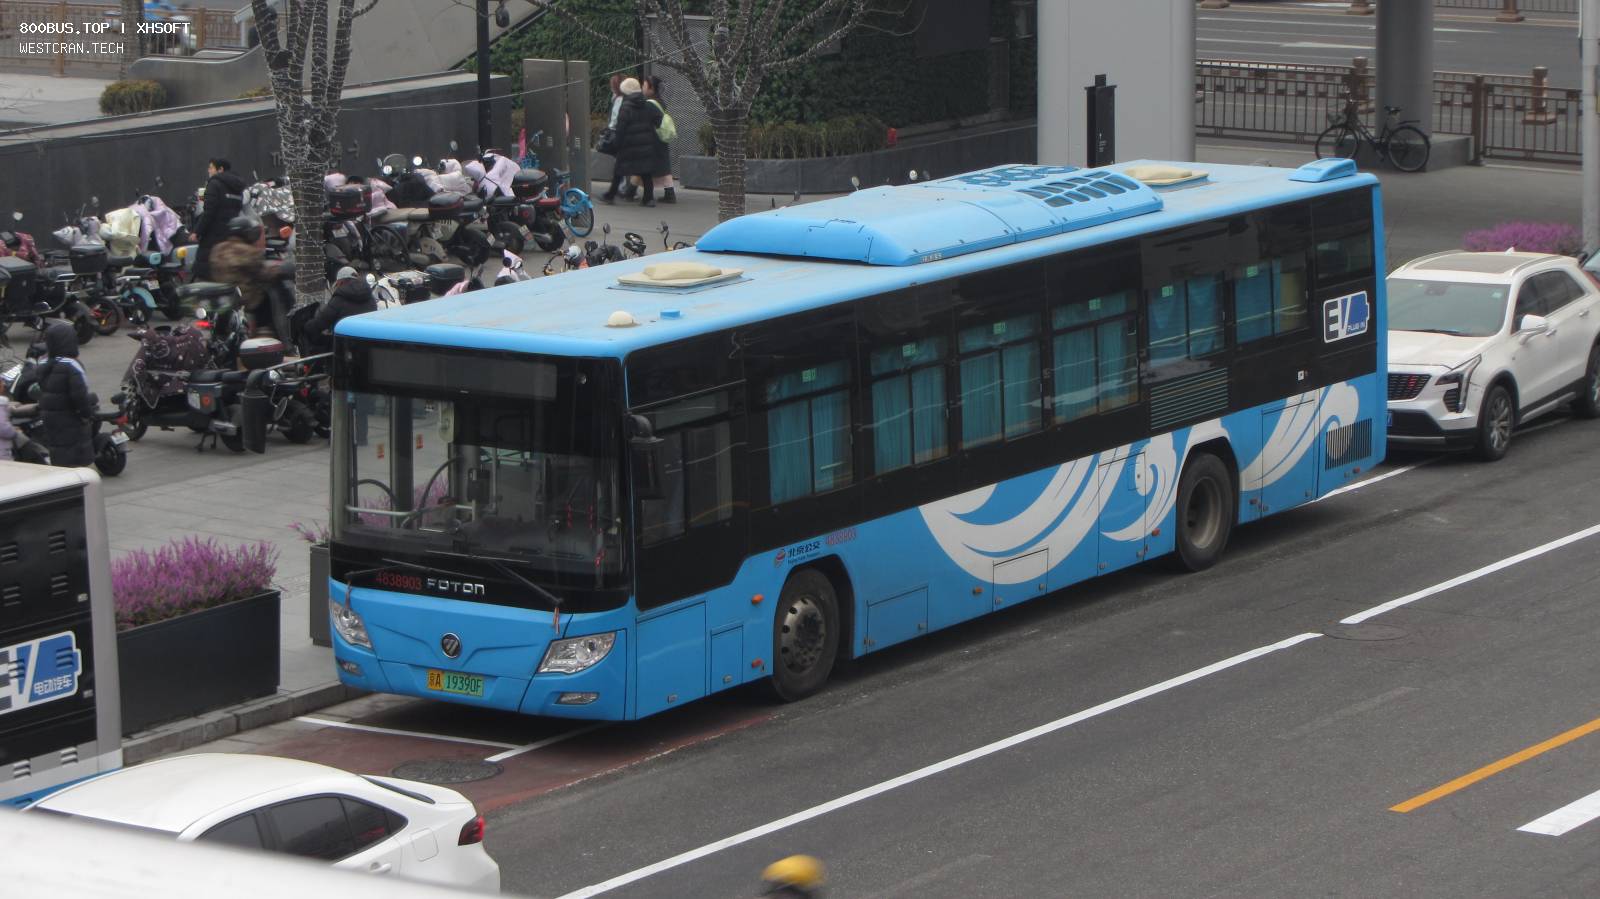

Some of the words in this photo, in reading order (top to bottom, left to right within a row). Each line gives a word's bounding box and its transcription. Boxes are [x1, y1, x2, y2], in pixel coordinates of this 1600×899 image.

[788, 541, 820, 558] 北京公交
[427, 578, 485, 595] FOTON
[34, 674, 73, 695] 电动汽车
